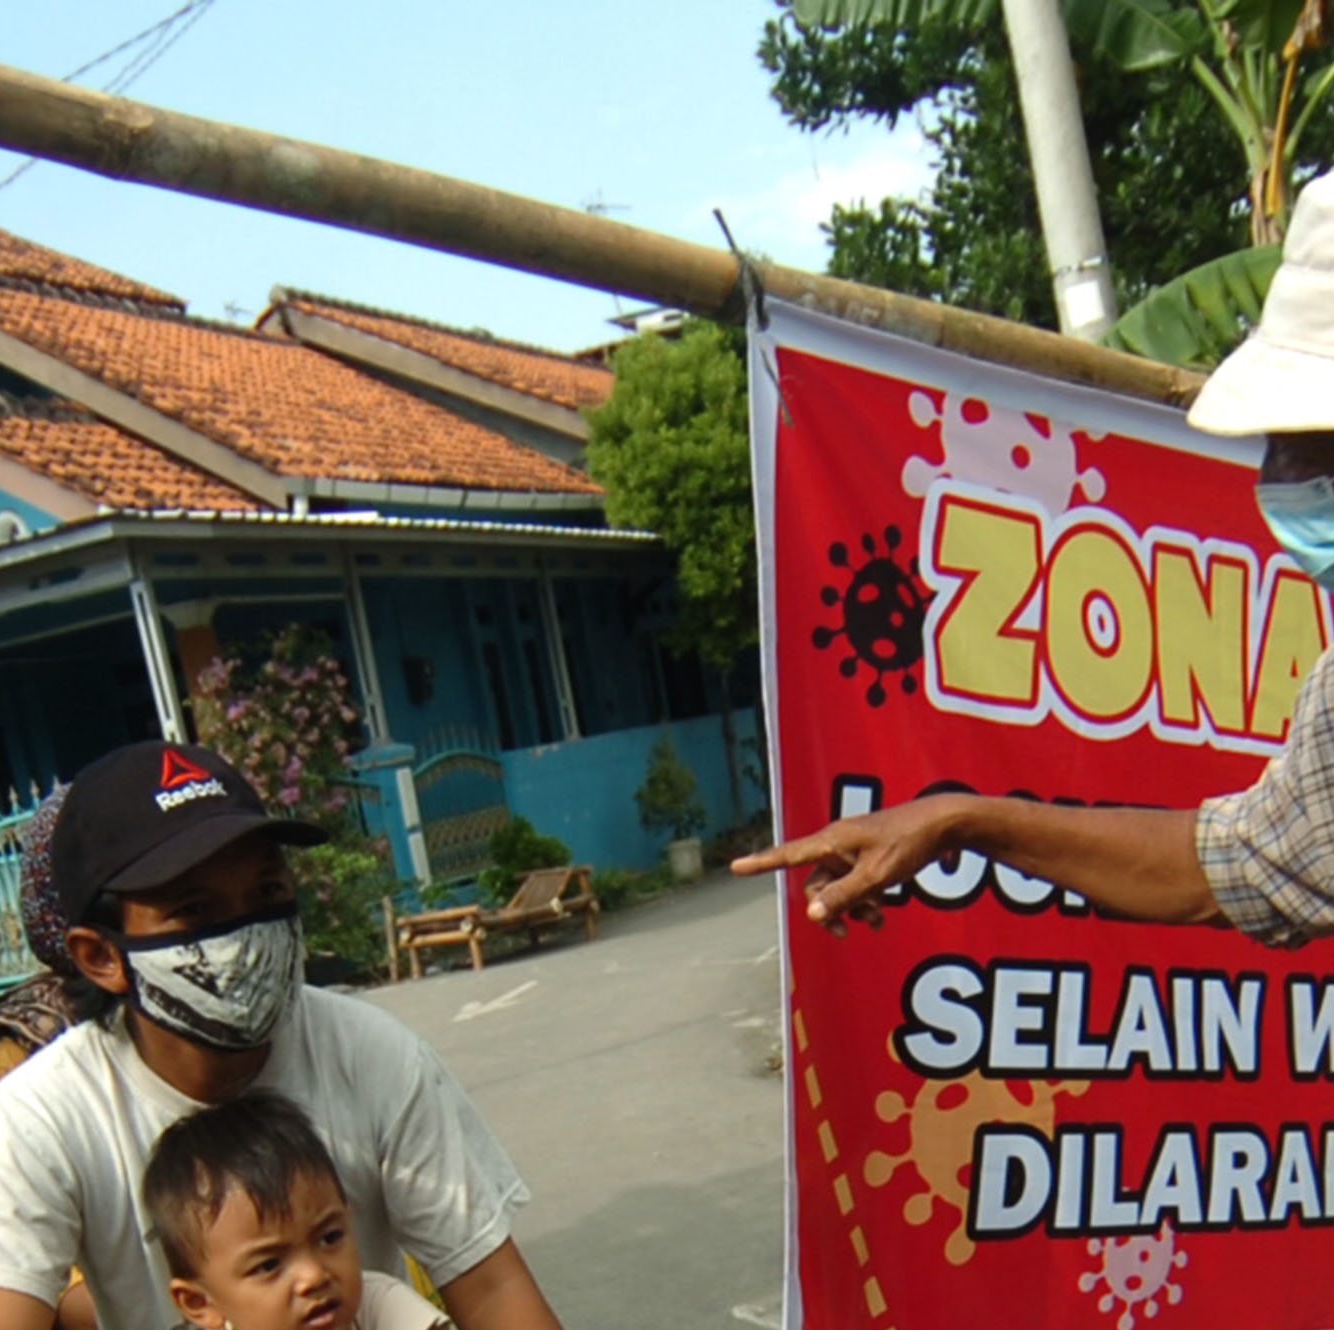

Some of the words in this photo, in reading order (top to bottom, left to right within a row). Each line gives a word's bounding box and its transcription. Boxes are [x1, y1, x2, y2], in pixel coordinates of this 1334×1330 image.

[927, 484, 1333, 750] ZONA
[155, 777, 228, 812] Reebok
[902, 962, 1263, 1074] SELAIN
